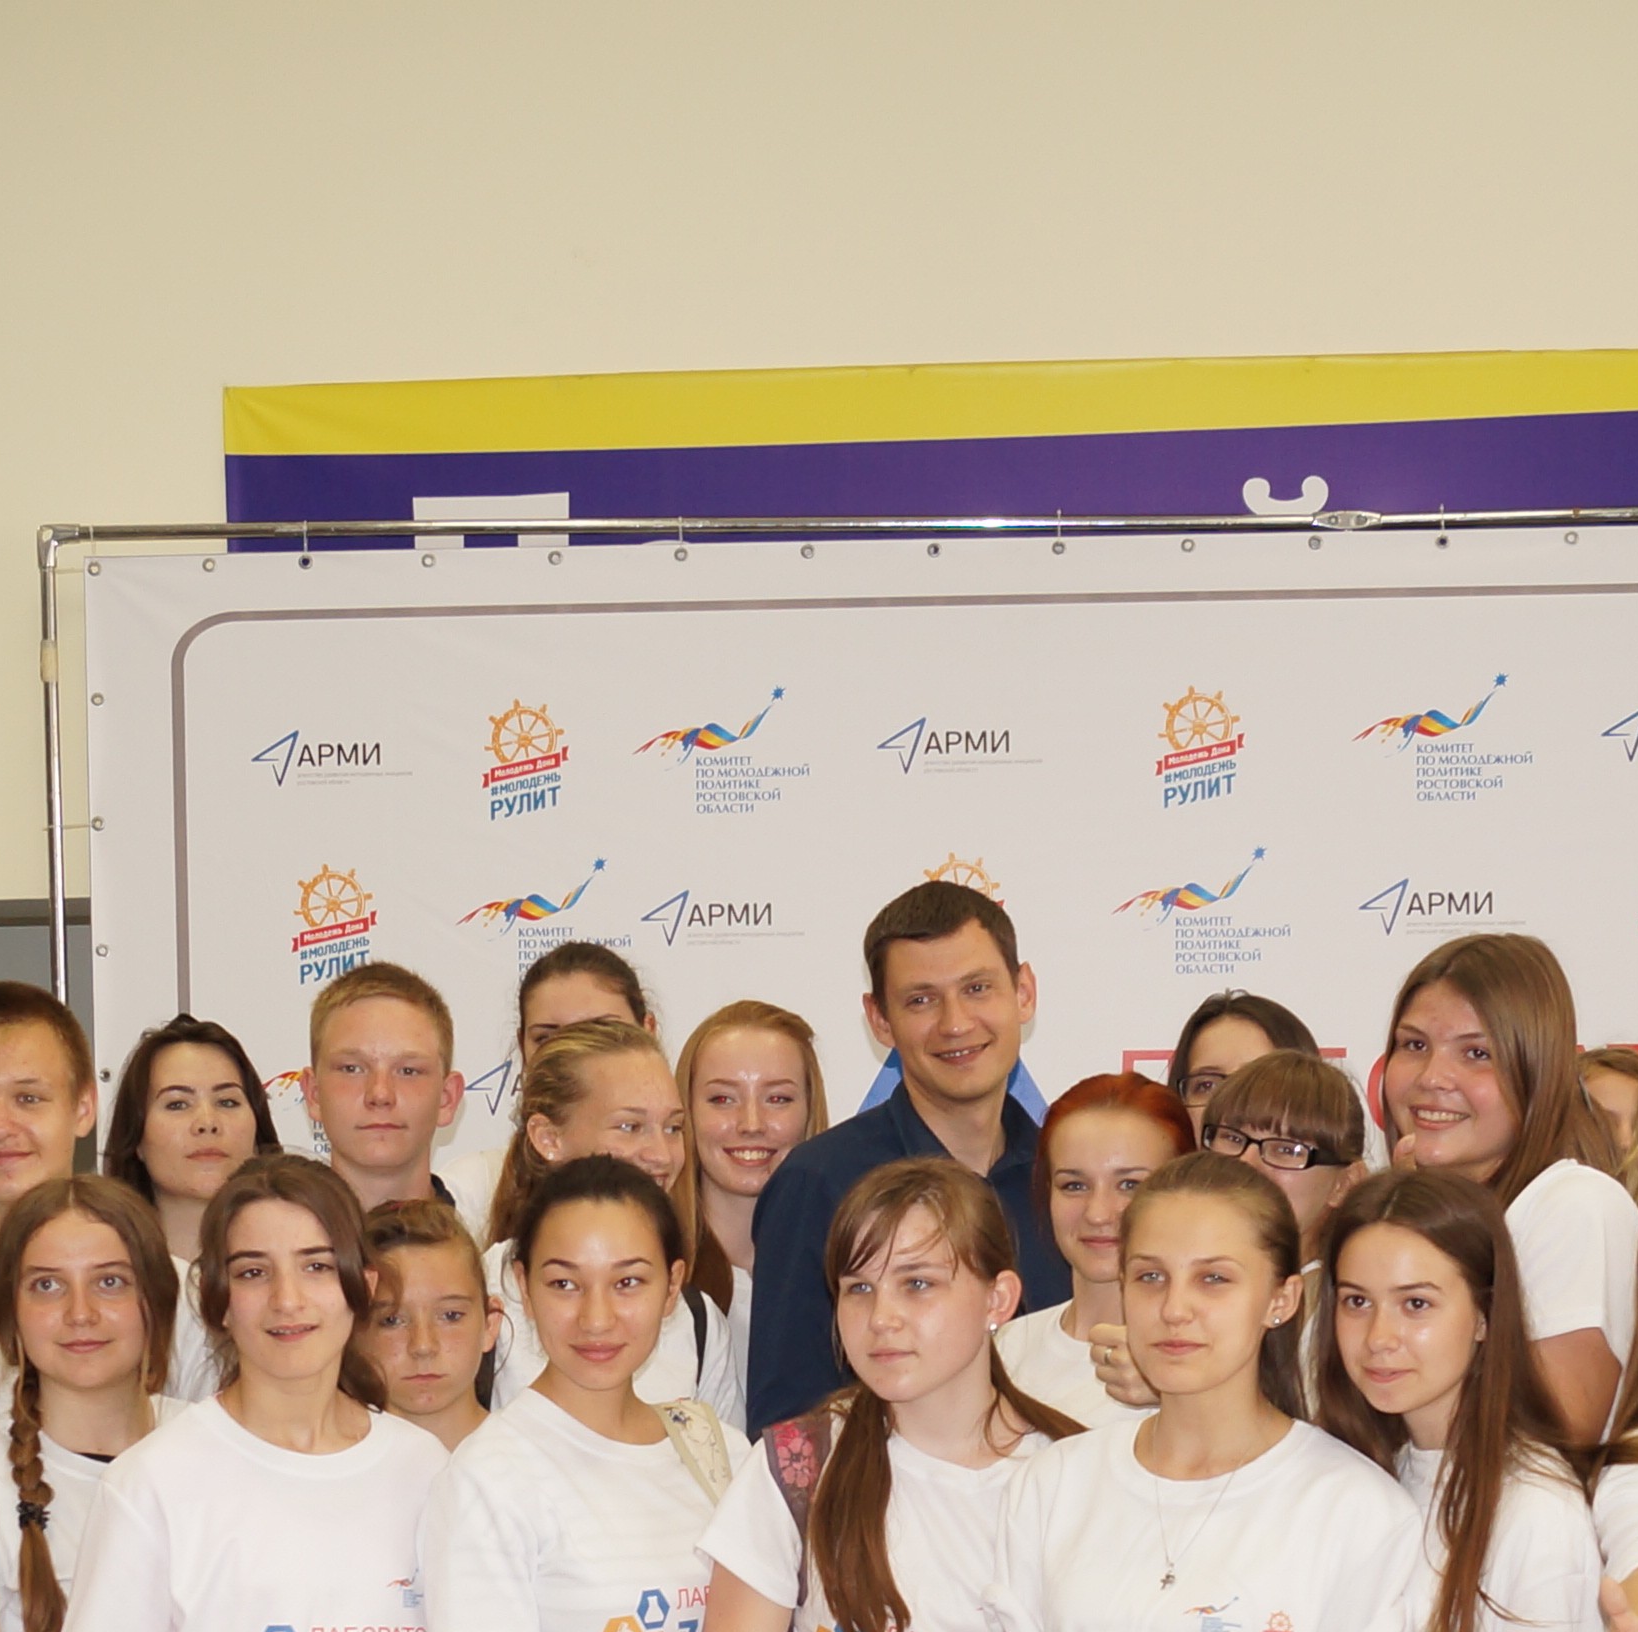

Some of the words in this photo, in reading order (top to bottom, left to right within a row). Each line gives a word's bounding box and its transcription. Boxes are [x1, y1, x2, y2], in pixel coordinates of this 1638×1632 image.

[924, 729, 1010, 754] АРМИ
[1416, 743, 1474, 753] КОМИТЕТ
[297, 742, 381, 767] АРМИ
[1416, 755, 1435, 765] ПО
[696, 756, 752, 767] КОМИТЕТ
[696, 768, 714, 778] ПО
[1416, 767, 1482, 777] ПОЛИТИКЕ
[696, 779, 760, 790] ПОЛИТИКЕ
[1416, 775, 1503, 789] РОСТОВСКОЙ
[696, 788, 781, 802] РОСТОВСКОЙ
[1164, 772, 1236, 809] РУЛИТ
[1416, 791, 1476, 801] ОБЛАСТИ
[490, 785, 561, 820] РУЛИТ
[696, 803, 754, 814] ОБЛАСТИ
[1407, 891, 1493, 916] АРМИ
[687, 902, 773, 927] АРМИ
[1175, 916, 1232, 927] КОМИТЕТ
[518, 927, 574, 937] КОМИТЕТ
[1175, 928, 1195, 938] ПО
[1175, 939, 1241, 950] ПОЛИТИКЕ
[1175, 949, 1261, 963] РОСТОВСКОЙ
[1175, 963, 1234, 974] ОБЛАСТИ
